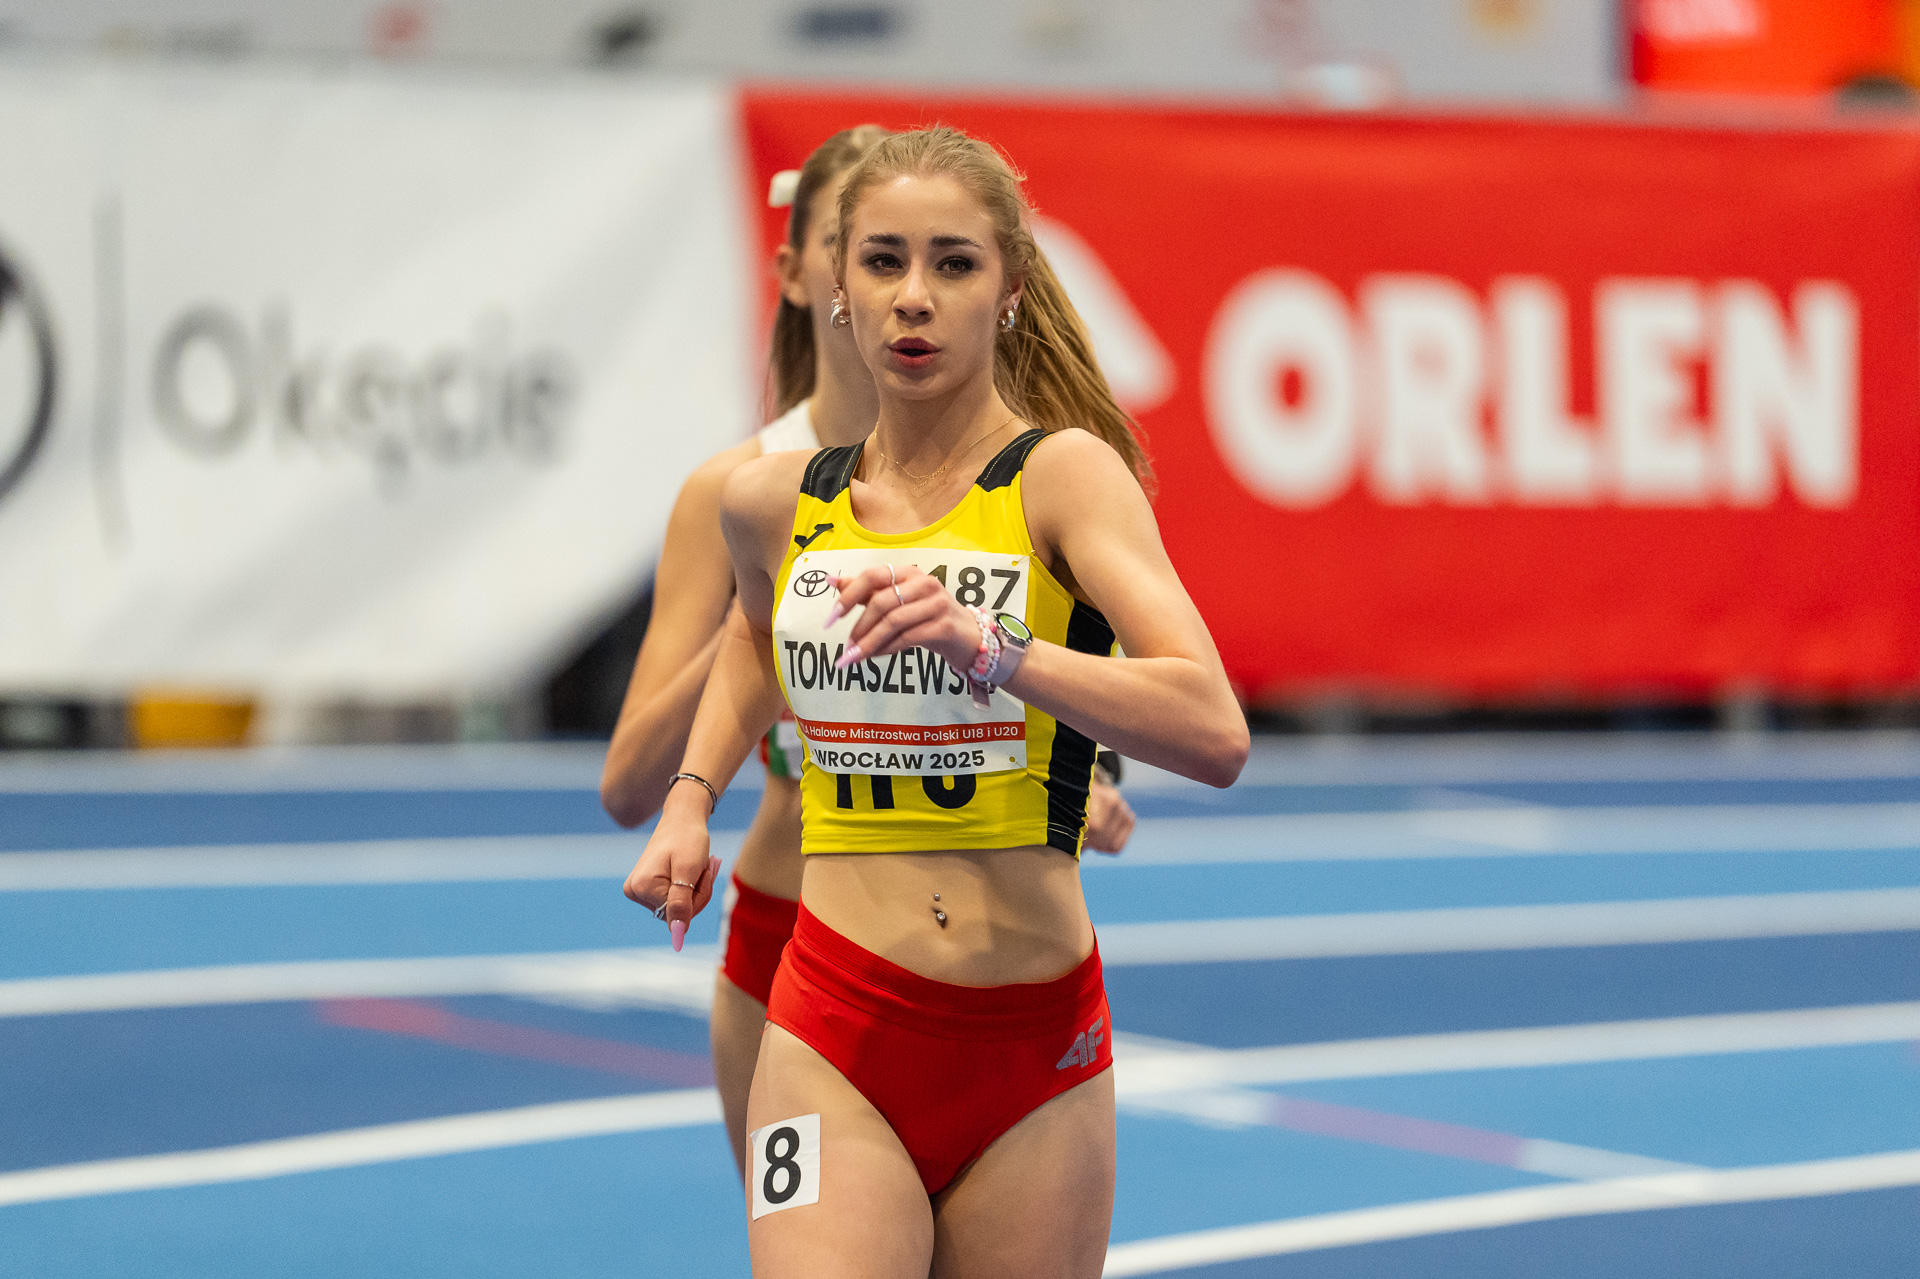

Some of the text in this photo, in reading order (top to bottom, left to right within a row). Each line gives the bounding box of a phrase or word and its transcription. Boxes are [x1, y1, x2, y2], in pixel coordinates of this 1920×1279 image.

[1204, 268, 1858, 510] ORLEN
[784, 640, 996, 696] TOMASZEWS
[810, 726, 847, 738] Halowe
[850, 728, 921, 741] Mistrzostwa
[923, 728, 959, 742] Polski
[962, 727, 984, 739] U18
[987, 726, 991, 738] i
[994, 726, 1018, 737] U20
[814, 748, 985, 770] WROCŁAW 2025
[763, 1126, 802, 1204] 8
